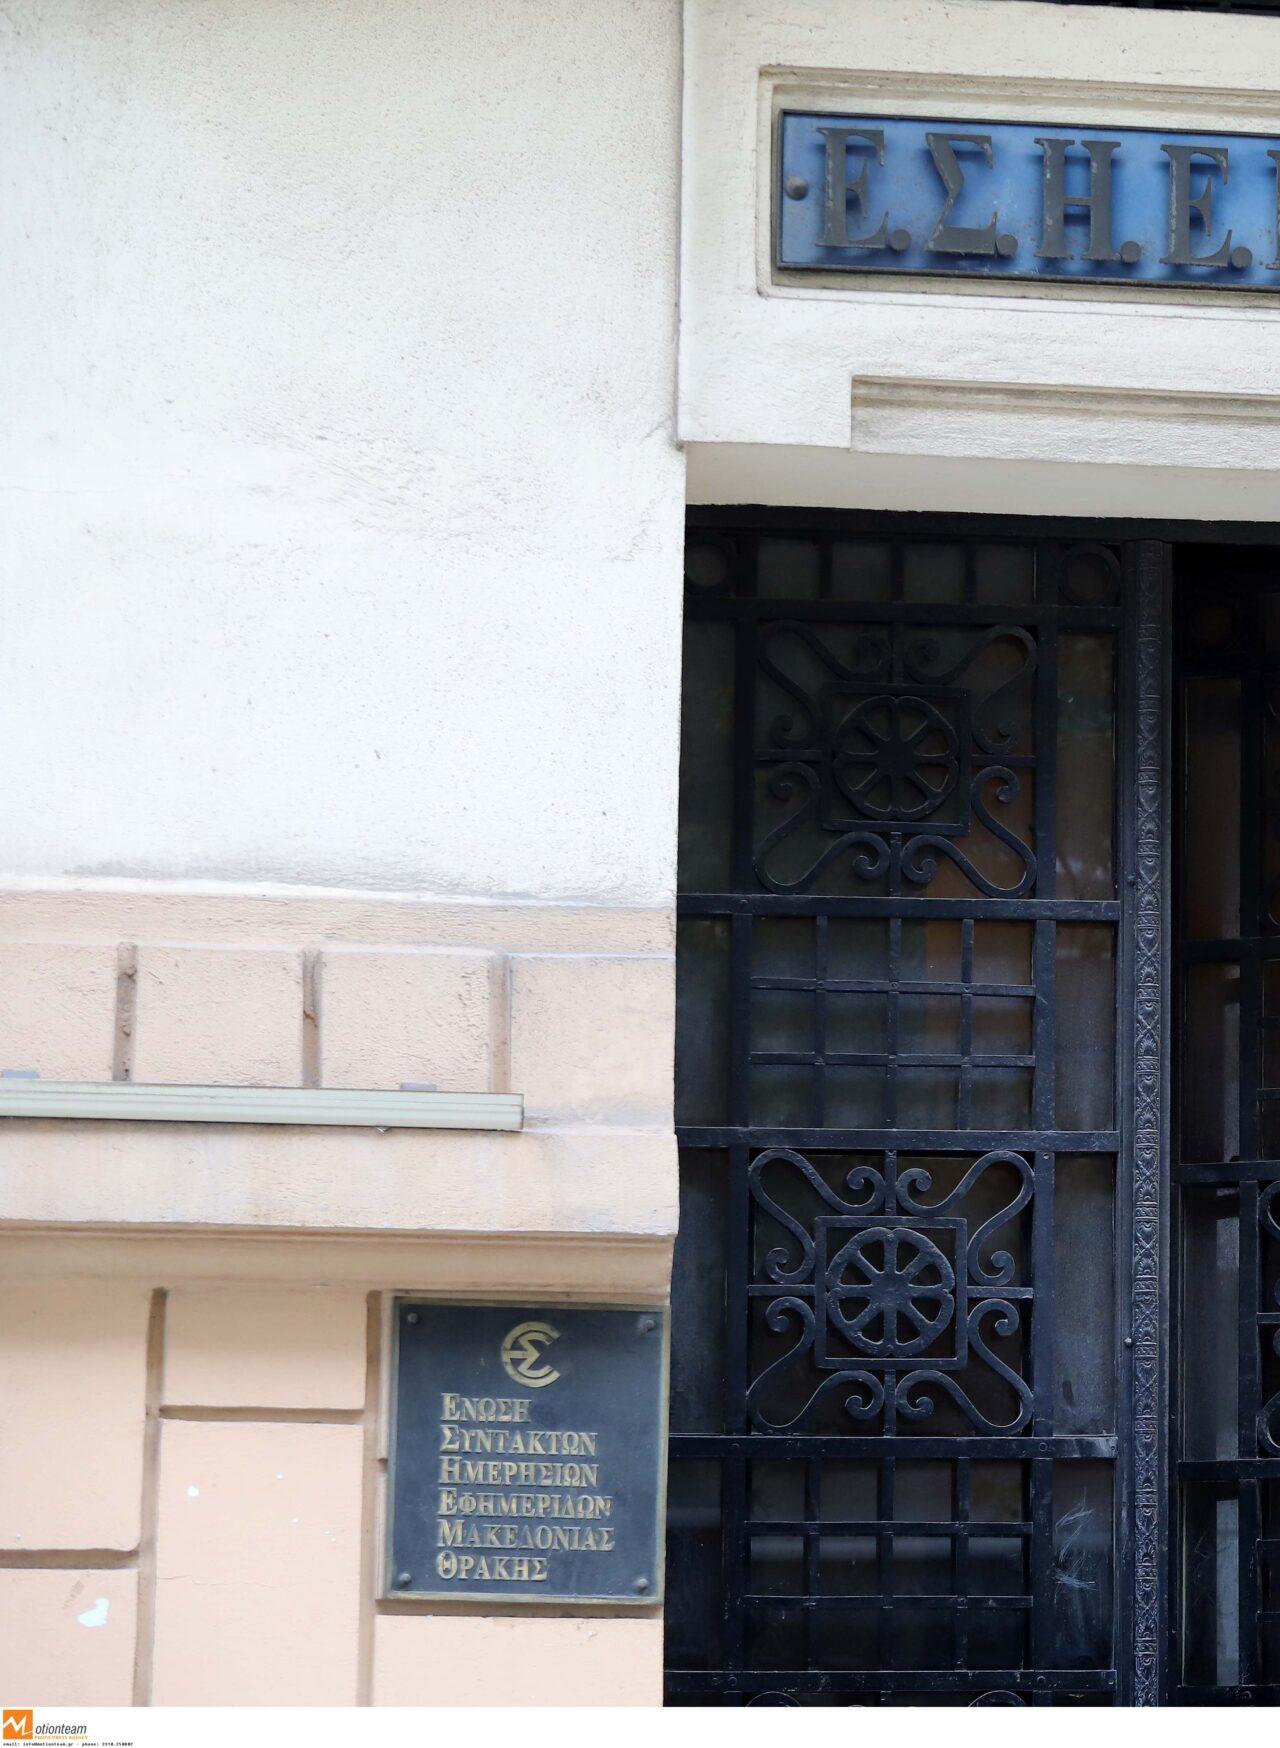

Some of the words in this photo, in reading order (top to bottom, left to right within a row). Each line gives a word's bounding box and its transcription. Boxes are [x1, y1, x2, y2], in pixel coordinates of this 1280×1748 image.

[440, 1393, 533, 1423] ΕΝΩΣΗ
[440, 1424, 599, 1457] ΣΥΝΤΑΚΤΩΝ
[438, 1456, 600, 1488] ΗΜΕΡΗΣΙΩΝ
[437, 1487, 613, 1520] ΕΦΗΜΕΡΙΔΩΝ
[436, 1518, 616, 1552] ΜΑΚΕΔΟΝΙΑΣ
[436, 1550, 549, 1582] ΘΡΑΚΗΣ
